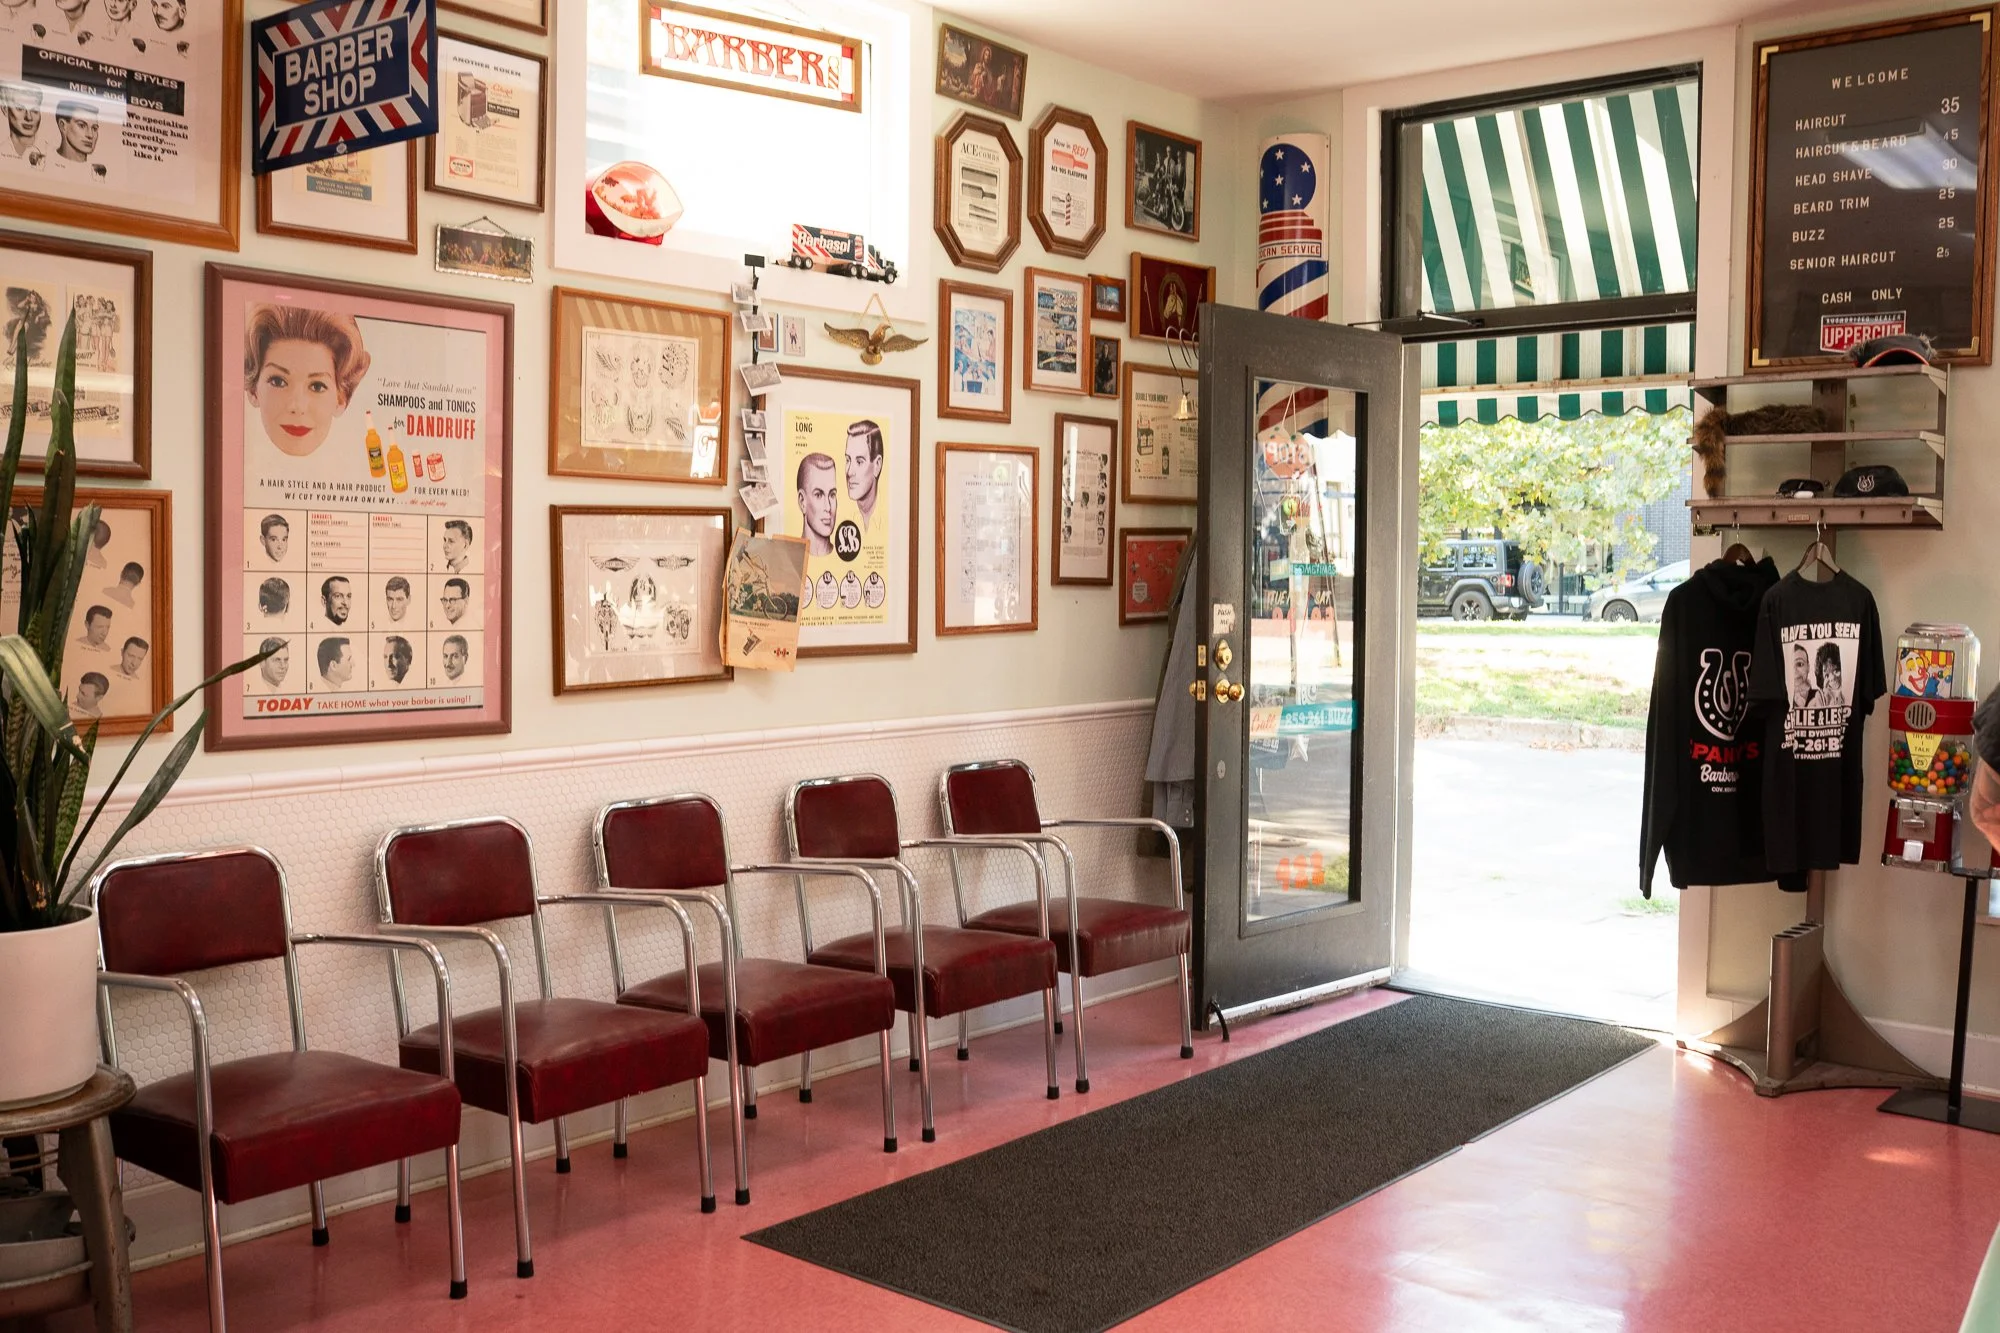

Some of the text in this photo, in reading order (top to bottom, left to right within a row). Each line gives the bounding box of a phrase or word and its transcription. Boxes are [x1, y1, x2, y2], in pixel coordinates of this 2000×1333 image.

[286, 25, 394, 87] BARBER
[453, 56, 490, 69] ANOTHER
[39, 50, 178, 90] OFFICIAL HAIR STYLES
[1832, 67, 1909, 90] WELCOME
[106, 78, 122, 88] for
[304, 66, 376, 116] SHOP
[70, 82, 164, 111] MEN and BOYS
[127, 112, 188, 130] We specialize
[1796, 96, 1960, 132] HAIRCUT 35
[134, 124, 168, 138] cutting
[170, 130, 188, 140] hair
[122, 138, 178, 157] the way you
[134, 150, 164, 162] like it.
[960, 142, 978, 156] ACE
[1054, 138, 1065, 148] Now
[1072, 144, 1089, 160] RED!
[1796, 142, 1847, 159] HAIRCUT
[1850, 140, 1859, 152] &
[1862, 135, 1907, 151] BEARD
[1796, 172, 1826, 187] HEAD
[1833, 168, 1872, 183] SHAVE
[1794, 187, 1956, 215] BEARD TRIM 25
[1792, 216, 1954, 244] BUZZ 25
[797, 230, 850, 253] Barbasol
[1281, 245, 1320, 255] SERVICE
[1790, 256, 1836, 270] SENIOR
[1842, 250, 1896, 267] HAIRCUT
[1822, 288, 1903, 304] CASH ONLY
[1826, 316, 1870, 324] AUTHORIZED
[404, 380, 420, 390] that
[378, 393, 476, 414] SHAMPOOS and TONICS
[394, 414, 476, 440] for DANDRUFF
[796, 422, 812, 433] LONG
[260, 478, 264, 488] A
[268, 479, 284, 488] HAIR
[288, 480, 309, 489] STYLE
[312, 482, 326, 490] AND
[330, 482, 334, 490] A
[336, 482, 353, 492] HAIR
[356, 483, 386, 493] PRODUCT
[414, 486, 426, 495] FOR
[428, 487, 448, 496] EVERY
[316, 494, 337, 502] YOUR
[340, 494, 358, 502] HAIR
[362, 496, 376, 504] ONE
[1780, 624, 1808, 643] HAVE
[1809, 622, 1832, 639] YOU
[257, 697, 314, 712] TODAY
[317, 701, 338, 710] TAKE
[340, 700, 366, 709] HOME
[369, 698, 390, 708] what
[392, 700, 409, 708] your
[412, 696, 436, 705] barber
[438, 696, 445, 704] is
[1818, 710, 1825, 726] &
